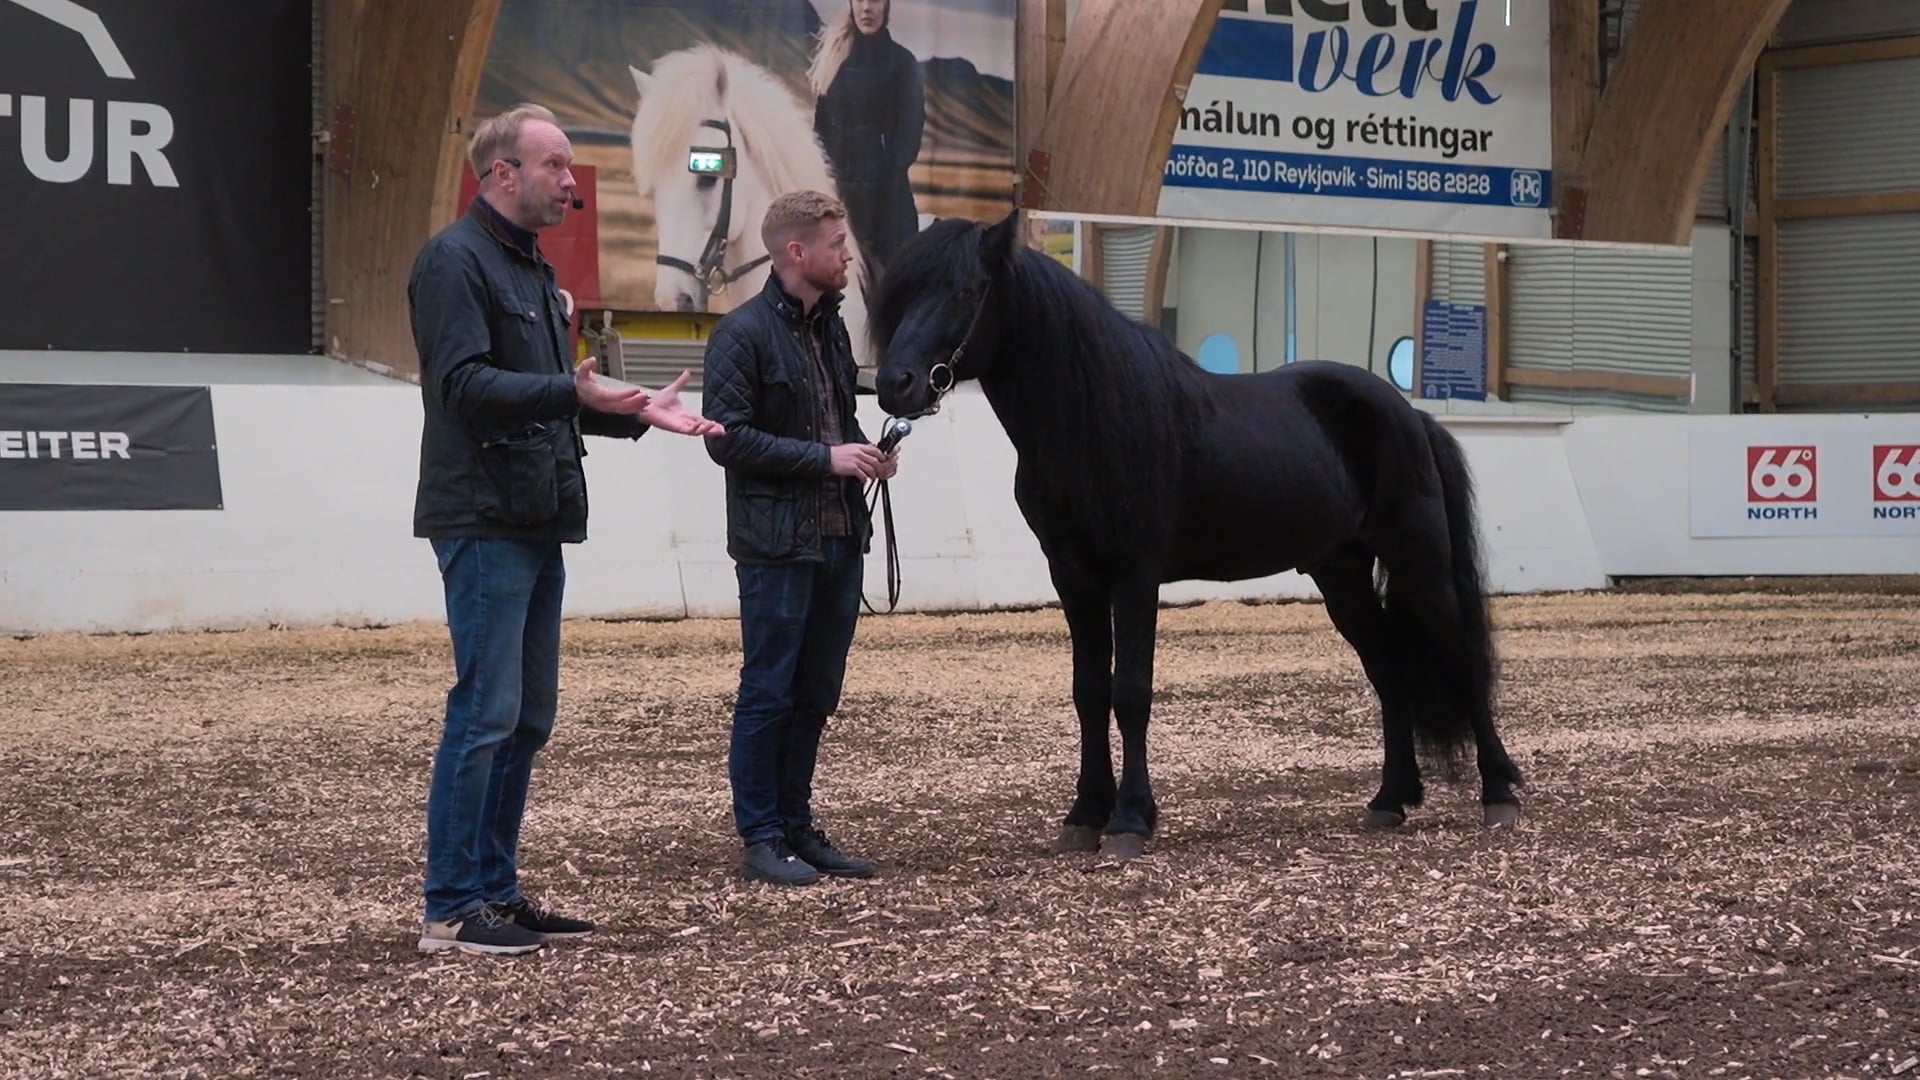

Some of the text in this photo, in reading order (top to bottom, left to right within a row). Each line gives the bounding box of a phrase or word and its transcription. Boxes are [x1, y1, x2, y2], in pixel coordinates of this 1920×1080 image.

[1298, 0, 1502, 104] verk
[0, 93, 179, 188] UR
[1292, 116, 1336, 150] og
[1347, 113, 1493, 158] réttingar
[1222, 158, 1240, 182] 2,
[1242, 159, 1271, 182] 110
[1406, 170, 1440, 192] 586
[1444, 172, 1490, 196] 2828
[1512, 175, 1540, 202] PPG
[0, 431, 131, 459] EITER
[1747, 507, 1818, 520] NORTH
